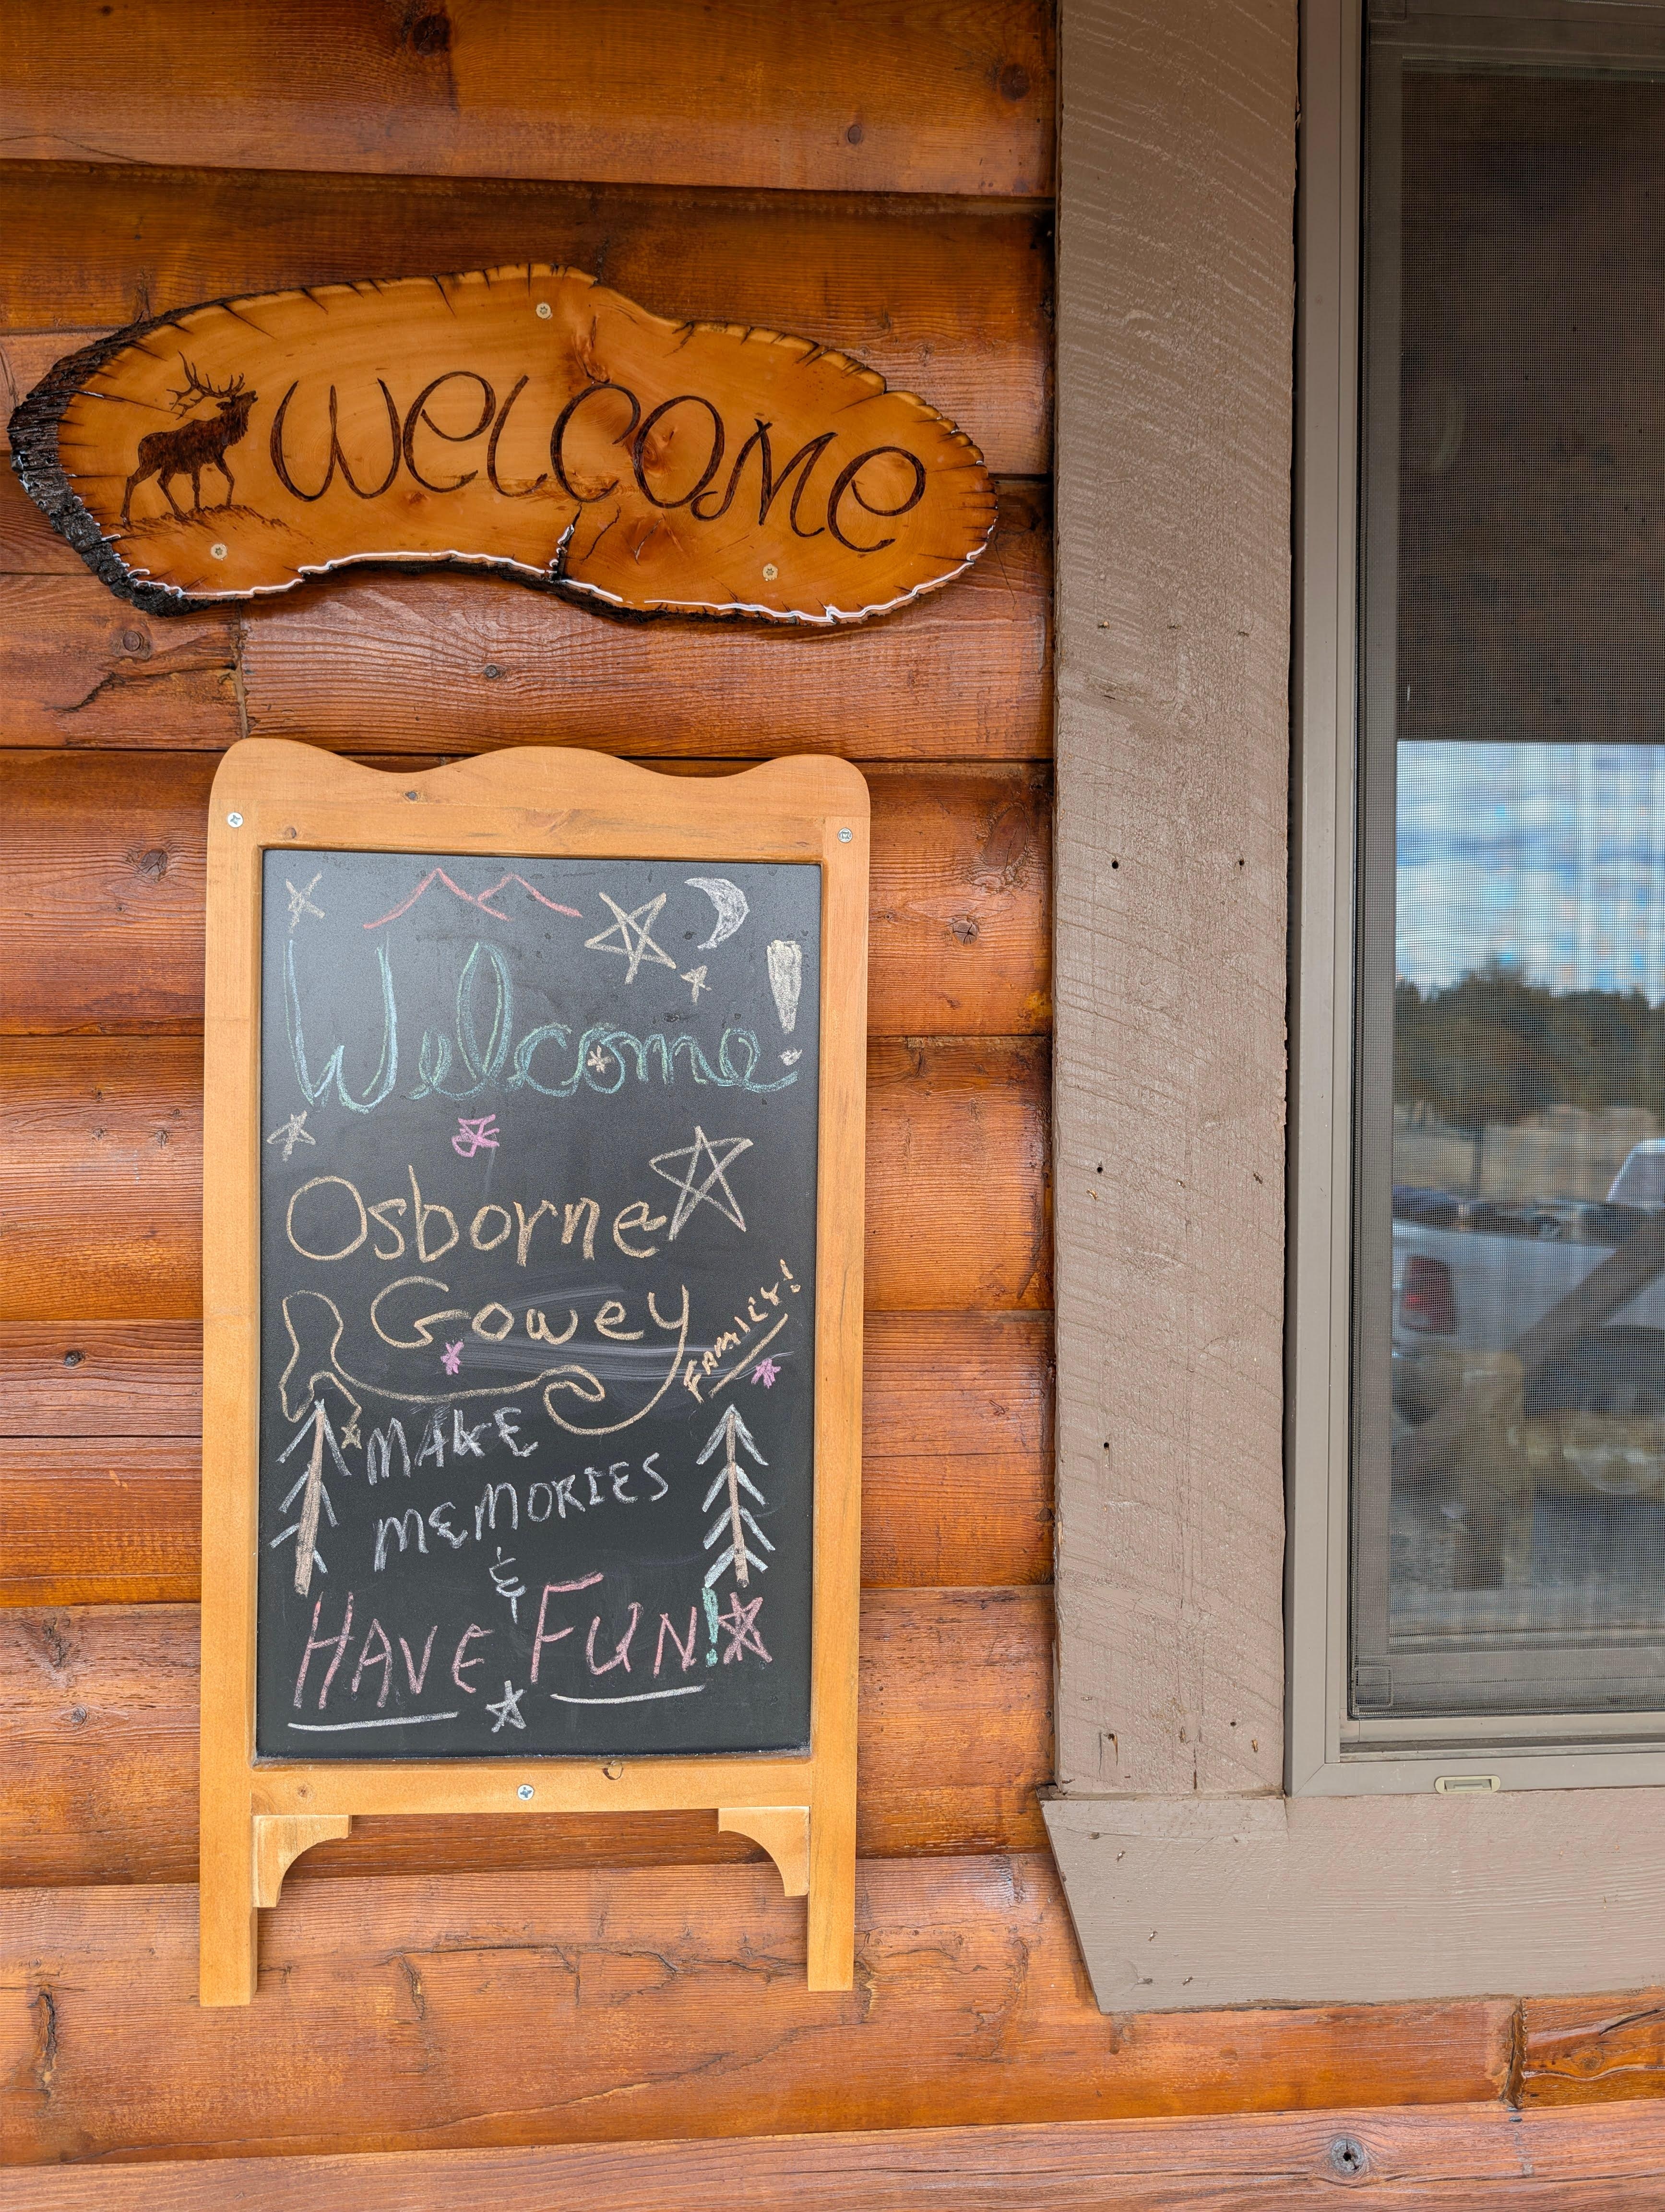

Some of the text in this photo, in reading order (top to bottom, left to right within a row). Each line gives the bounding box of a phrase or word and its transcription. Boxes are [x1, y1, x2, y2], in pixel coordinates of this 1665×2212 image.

[288, 1165, 667, 1267] Osborne
[369, 1276, 689, 1436] Gowey
[367, 1406, 538, 1485] MAKE
[373, 1452, 669, 1571] MEMORIES
[293, 1572, 719, 1710] HAVE FUN!
